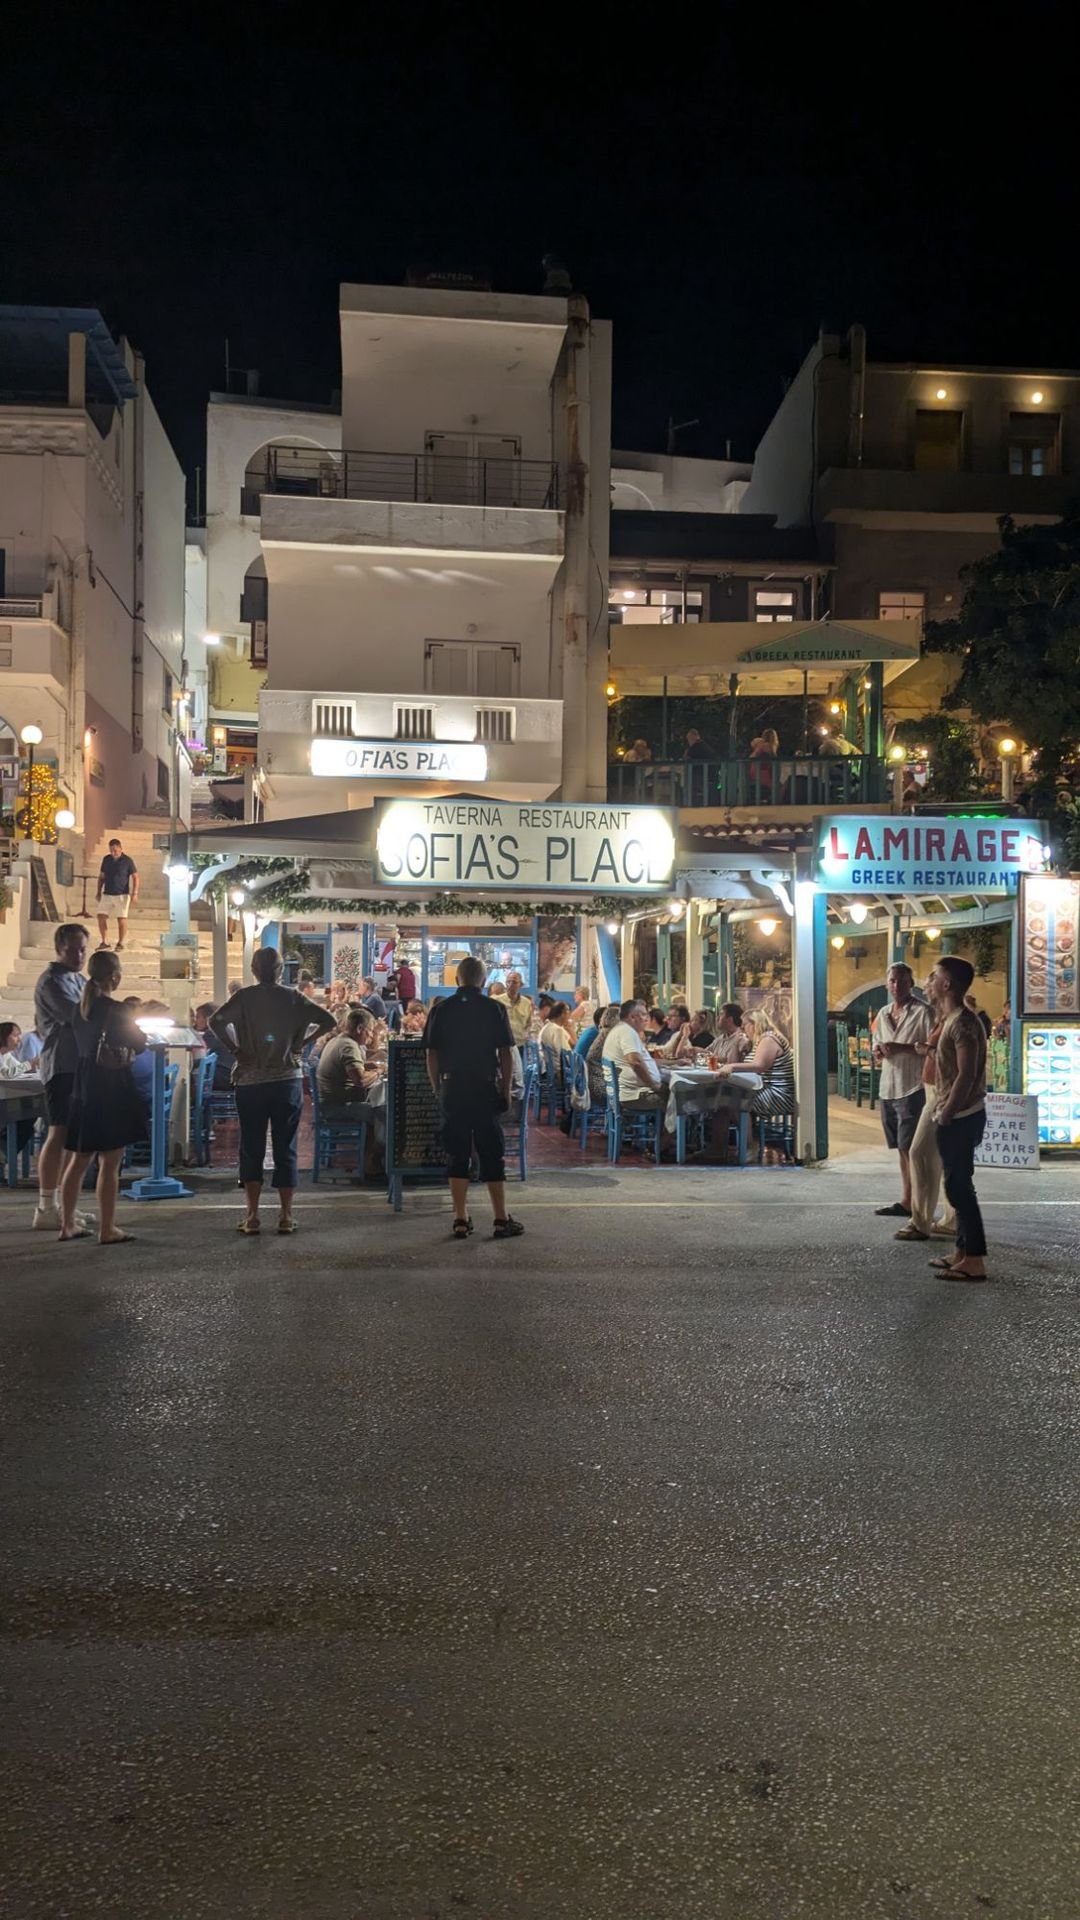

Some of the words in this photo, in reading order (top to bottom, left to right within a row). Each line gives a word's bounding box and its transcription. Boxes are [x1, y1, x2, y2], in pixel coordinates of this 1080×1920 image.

[794, 649, 862, 661] RESTAURANT
[345, 750, 408, 770] OFIA'S
[416, 752, 450, 771] PLA
[424, 805, 502, 826] TAVERNA
[519, 808, 631, 830] RESTAURANT
[852, 869, 905, 885] GREEK
[913, 870, 1018, 887] RESTAURANT
[998, 1120, 1026, 1130] ARE
[983, 1131, 1019, 1141] OPEN
[975, 1142, 1036, 1154] STAIRS
[974, 1153, 998, 1164] ALL
[1002, 1155, 1030, 1165] DAY
